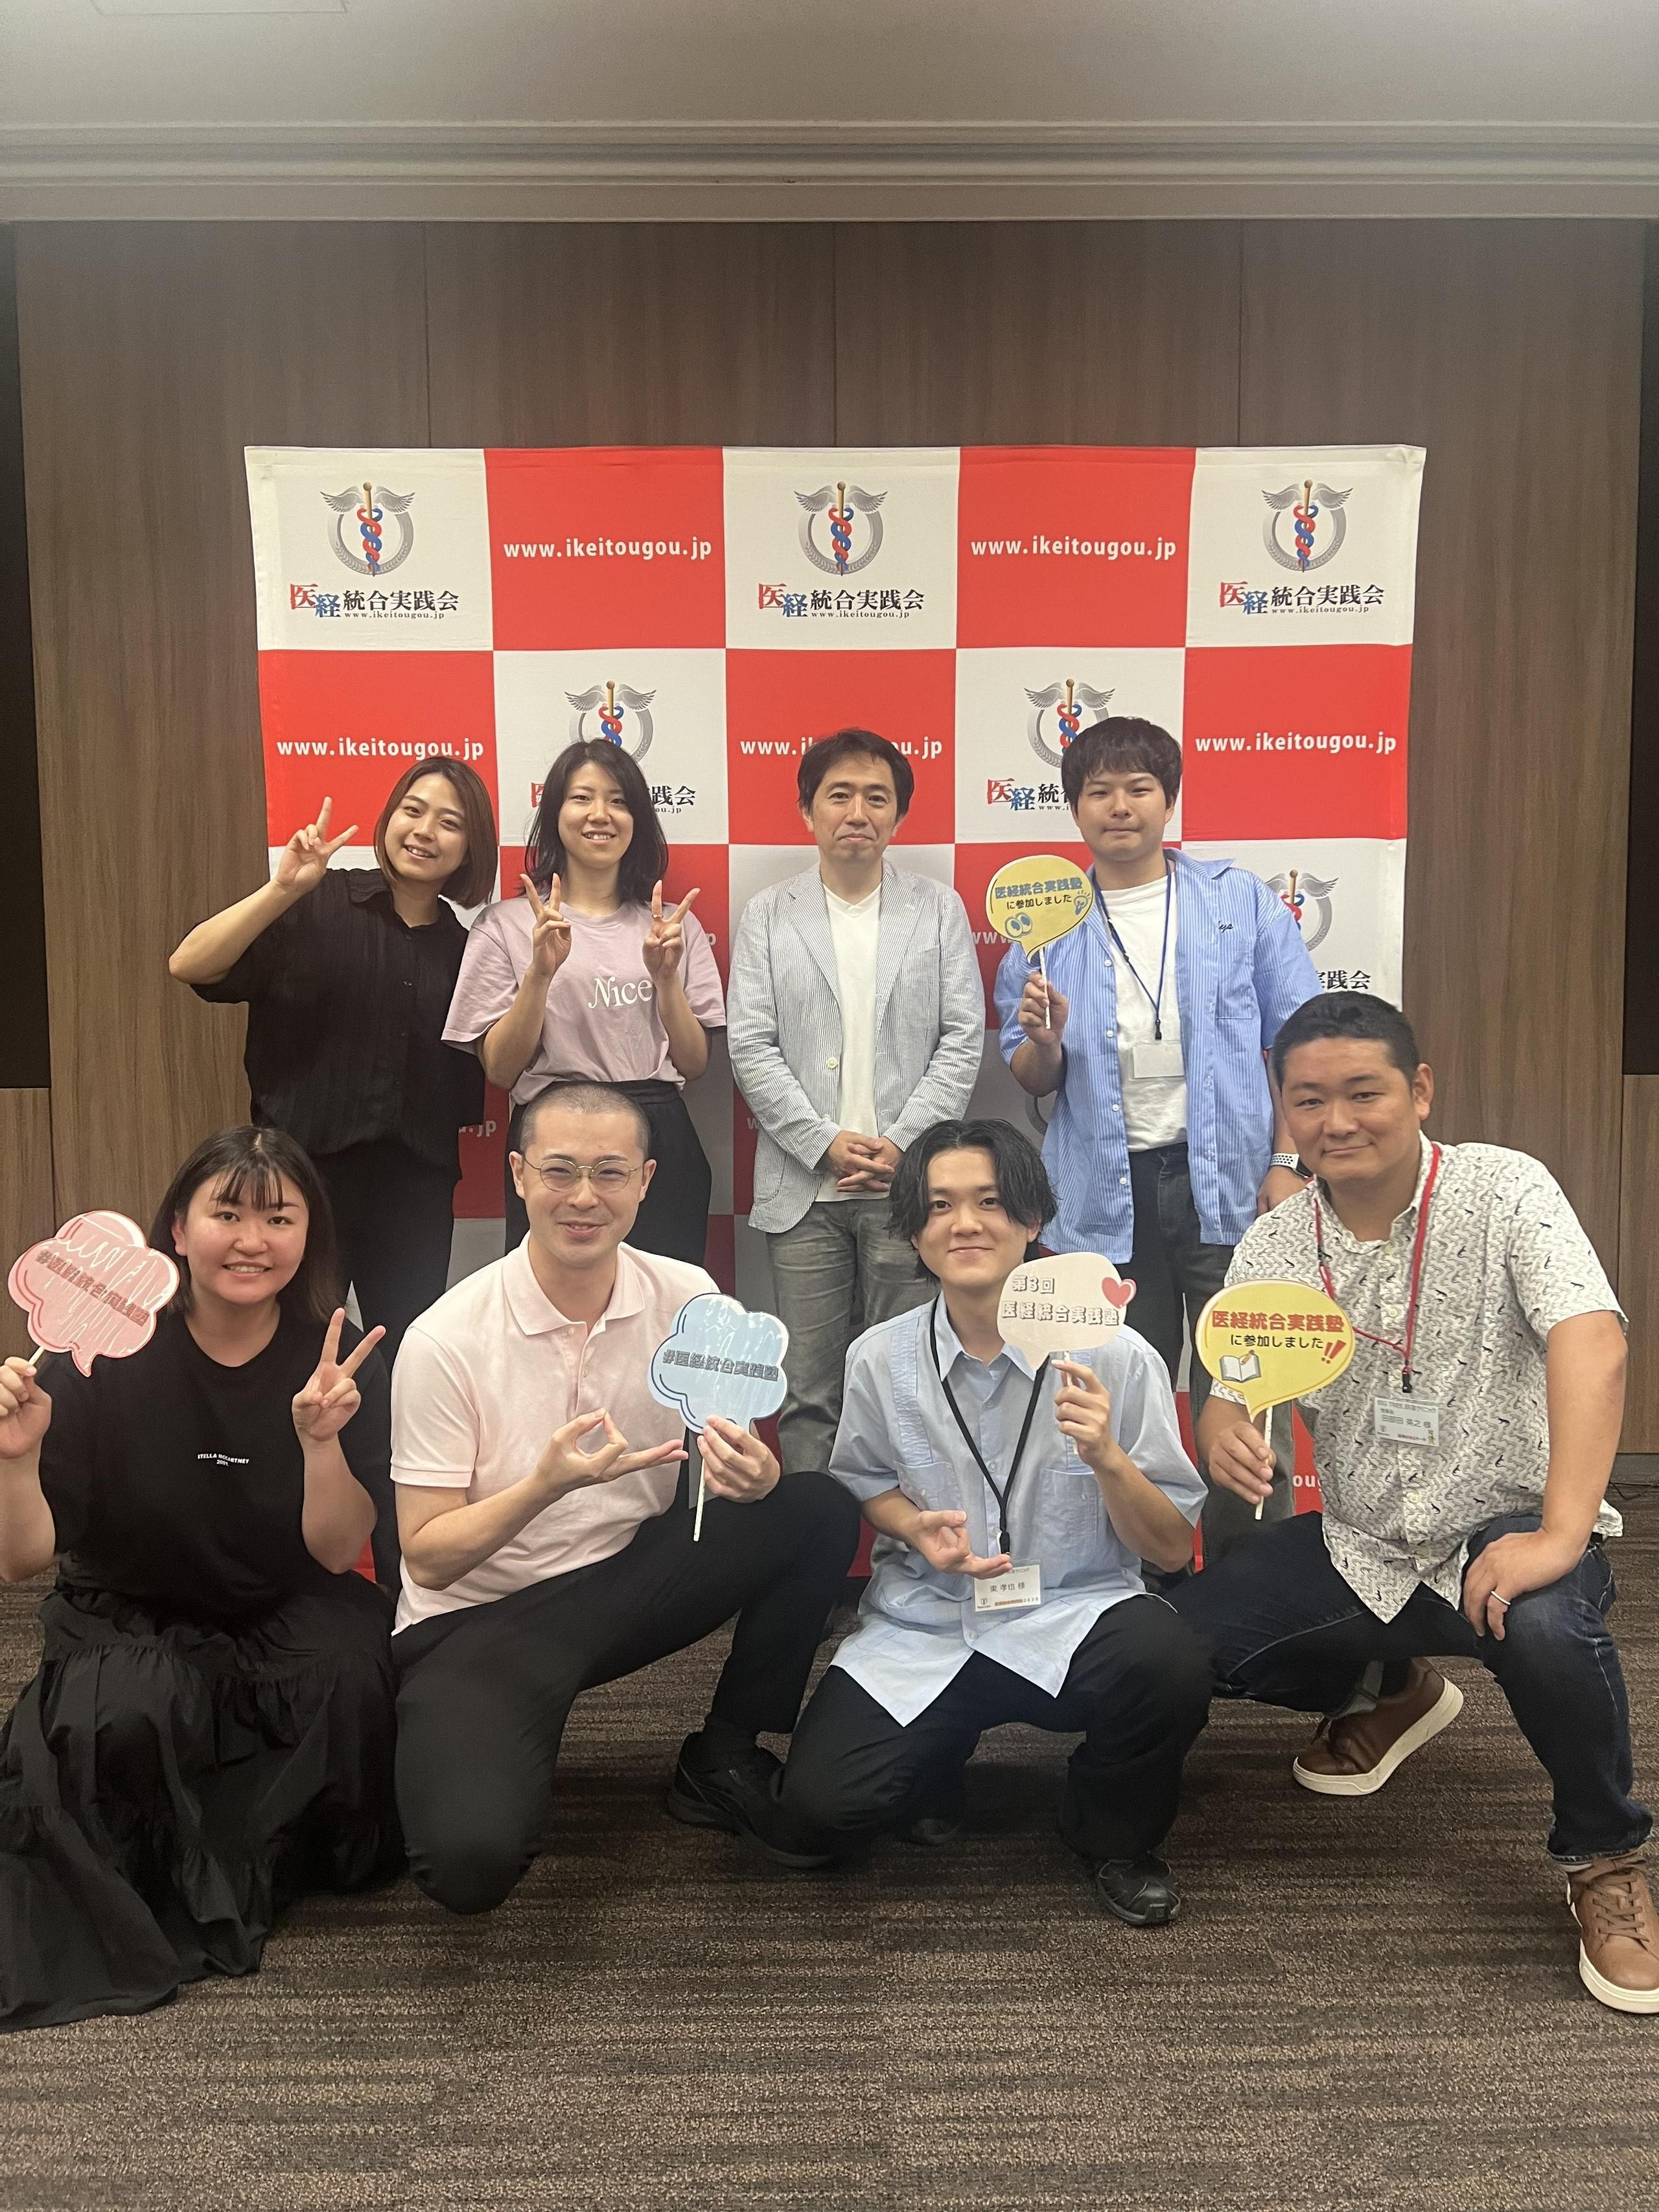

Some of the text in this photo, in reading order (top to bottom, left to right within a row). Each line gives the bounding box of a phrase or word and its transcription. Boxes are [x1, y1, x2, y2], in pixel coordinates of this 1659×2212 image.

[503, 537, 712, 560] www.ikeitougou.jp
[970, 535, 1177, 560] www.ikeitougou.jp
[290, 583, 459, 618] 医経統合実践会
[758, 583, 925, 618] 医経統合実践会
[1220, 581, 1385, 615] 医経統合実践会
[1271, 605, 1370, 614] www.ikeitougou.jp
[345, 611, 445, 620] www.ikeitougou.jp
[811, 610, 910, 619] www.ikeitougou.jp
[276, 737, 484, 761] www.ikeitougou.jp
[1195, 731, 1397, 754] www.ikeitougou.jp
[1006, 894, 1073, 910] に参加しました
[588, 976, 653, 1009] Nice
[1012, 1274, 1055, 1294] 第3回
[1212, 1310, 1345, 1333] 医経統合実践塾
[1230, 1334, 1325, 1349] に参加しました
